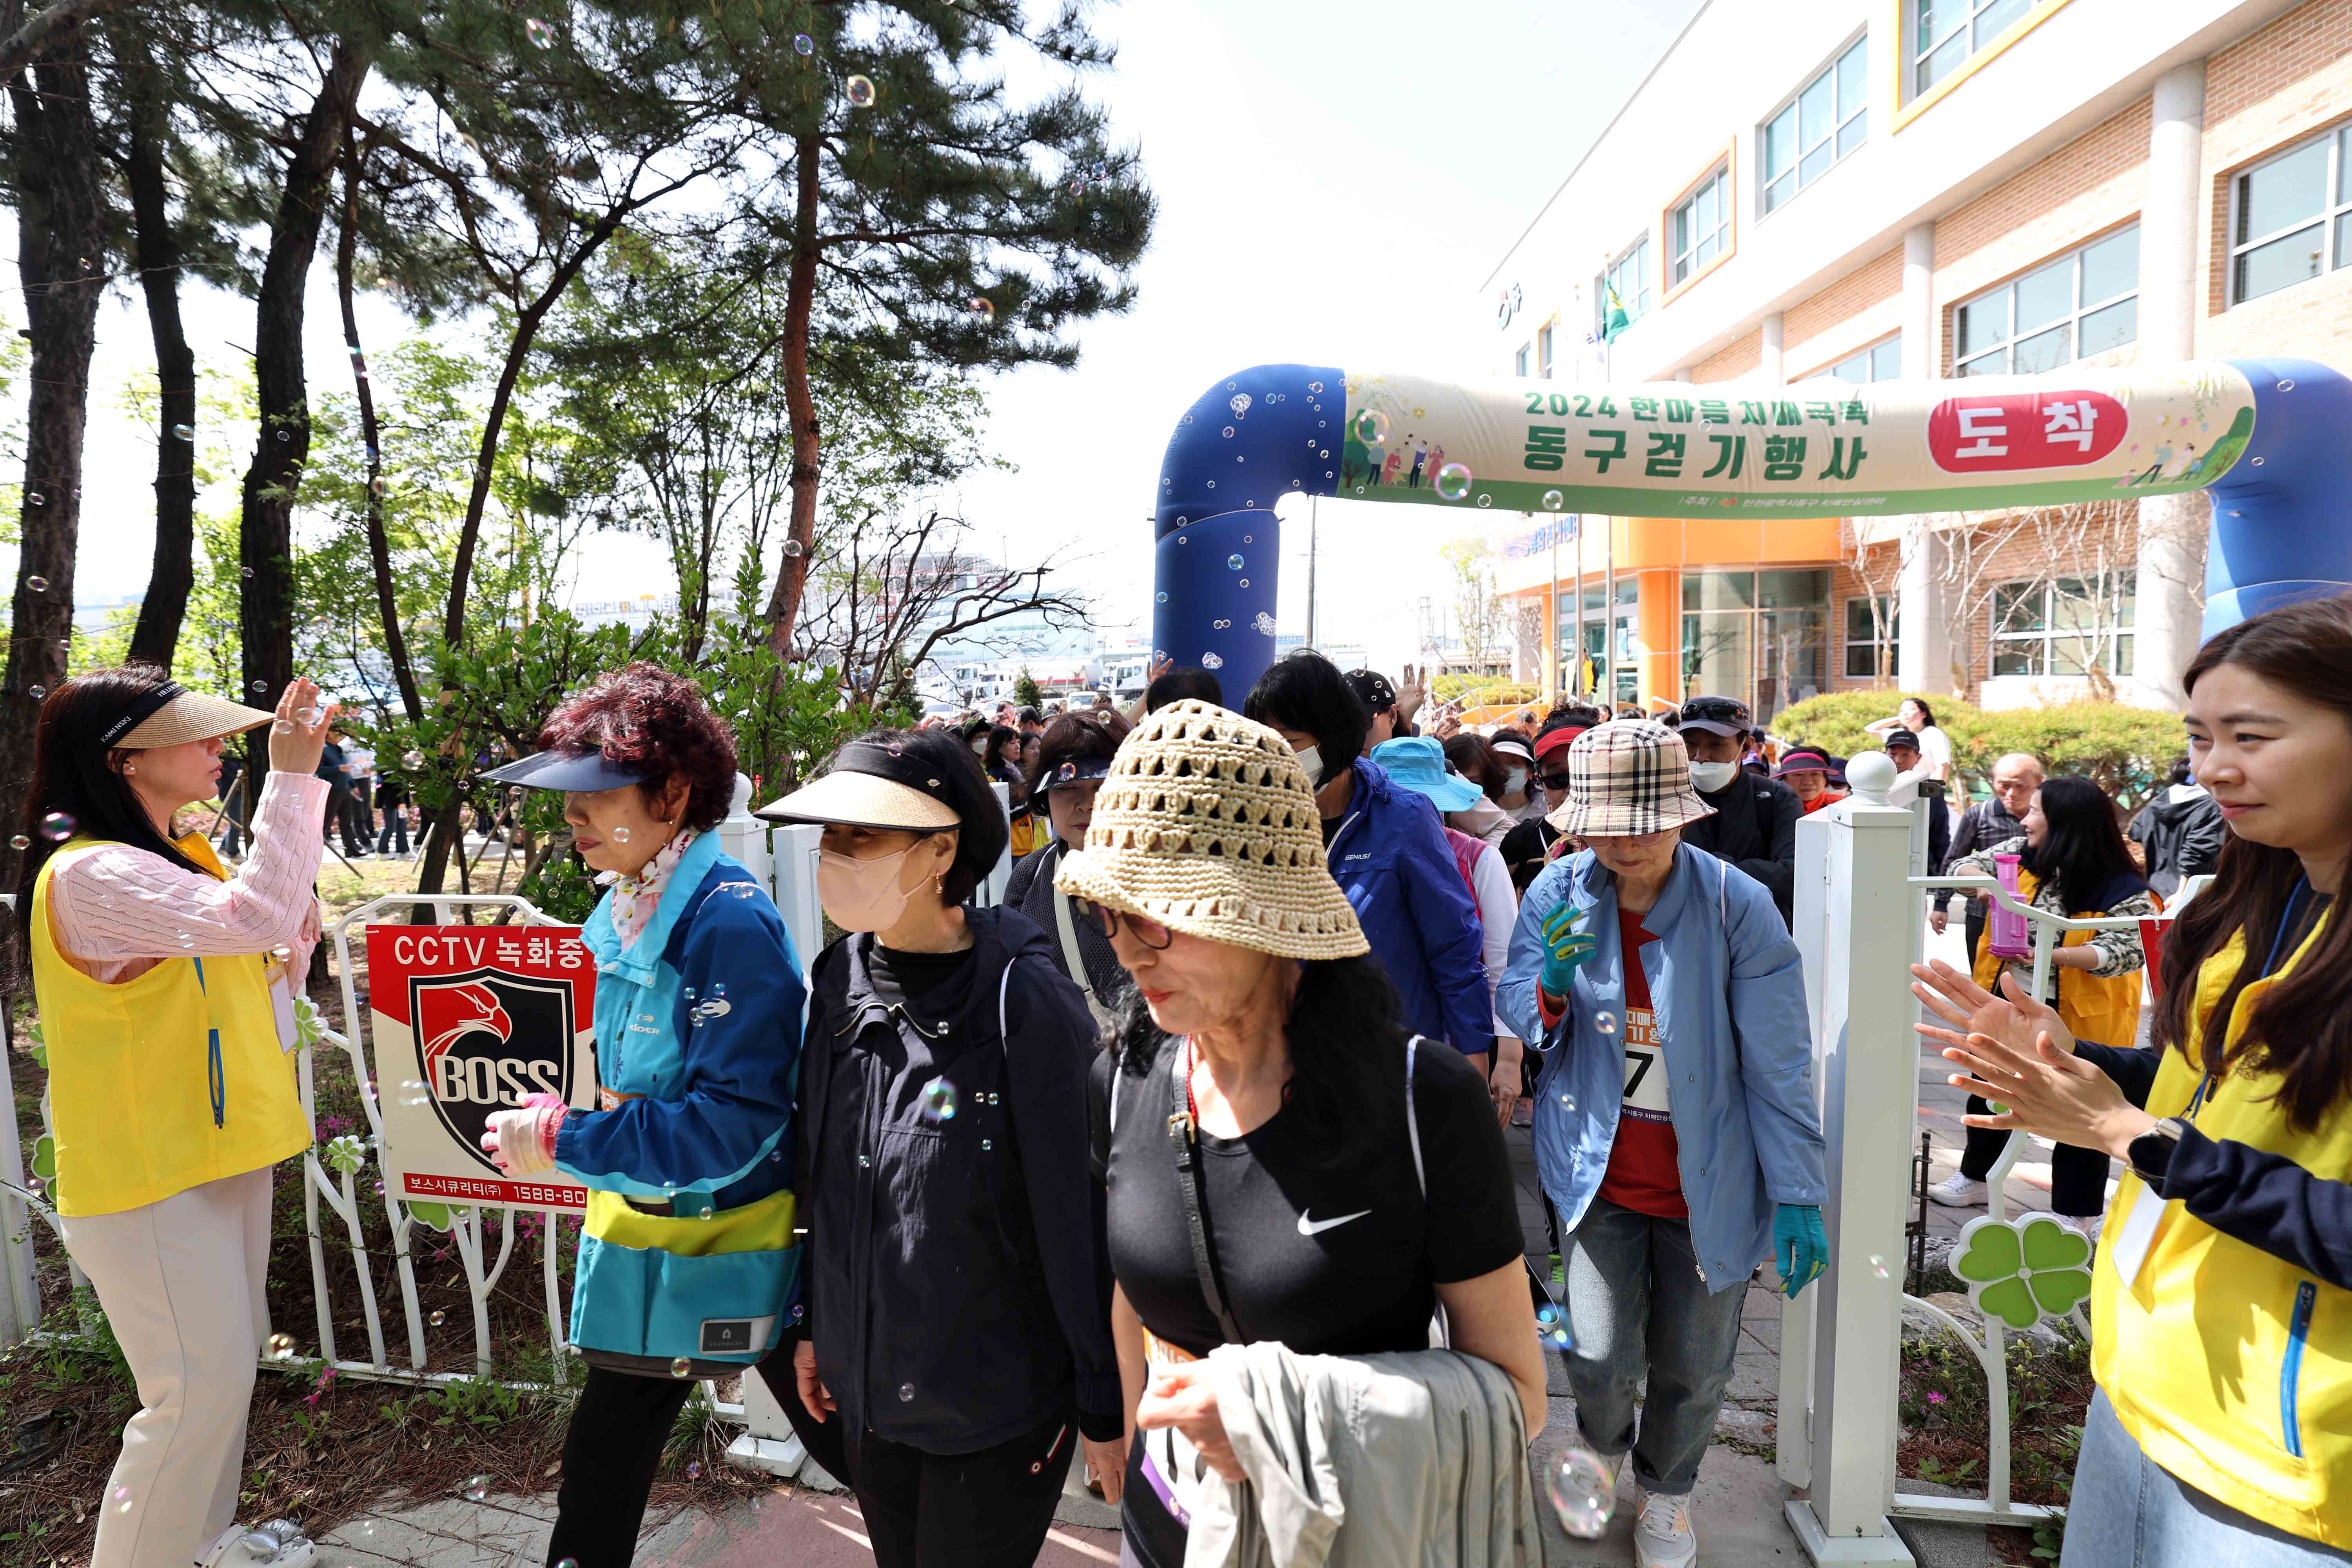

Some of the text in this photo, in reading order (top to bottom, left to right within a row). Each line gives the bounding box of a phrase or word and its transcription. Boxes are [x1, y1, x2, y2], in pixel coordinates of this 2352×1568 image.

[1525, 392, 1617, 418] 2024
[1629, 396, 1729, 424] 한마음
[1955, 401, 2098, 457] 도착
[157, 684, 176, 697] HELEN
[100, 716, 132, 742] KAMINSKI
[394, 936, 584, 968] CCTV 녹화중
[434, 1055, 561, 1105] BOSS
[1623, 1051, 1653, 1098] 7
